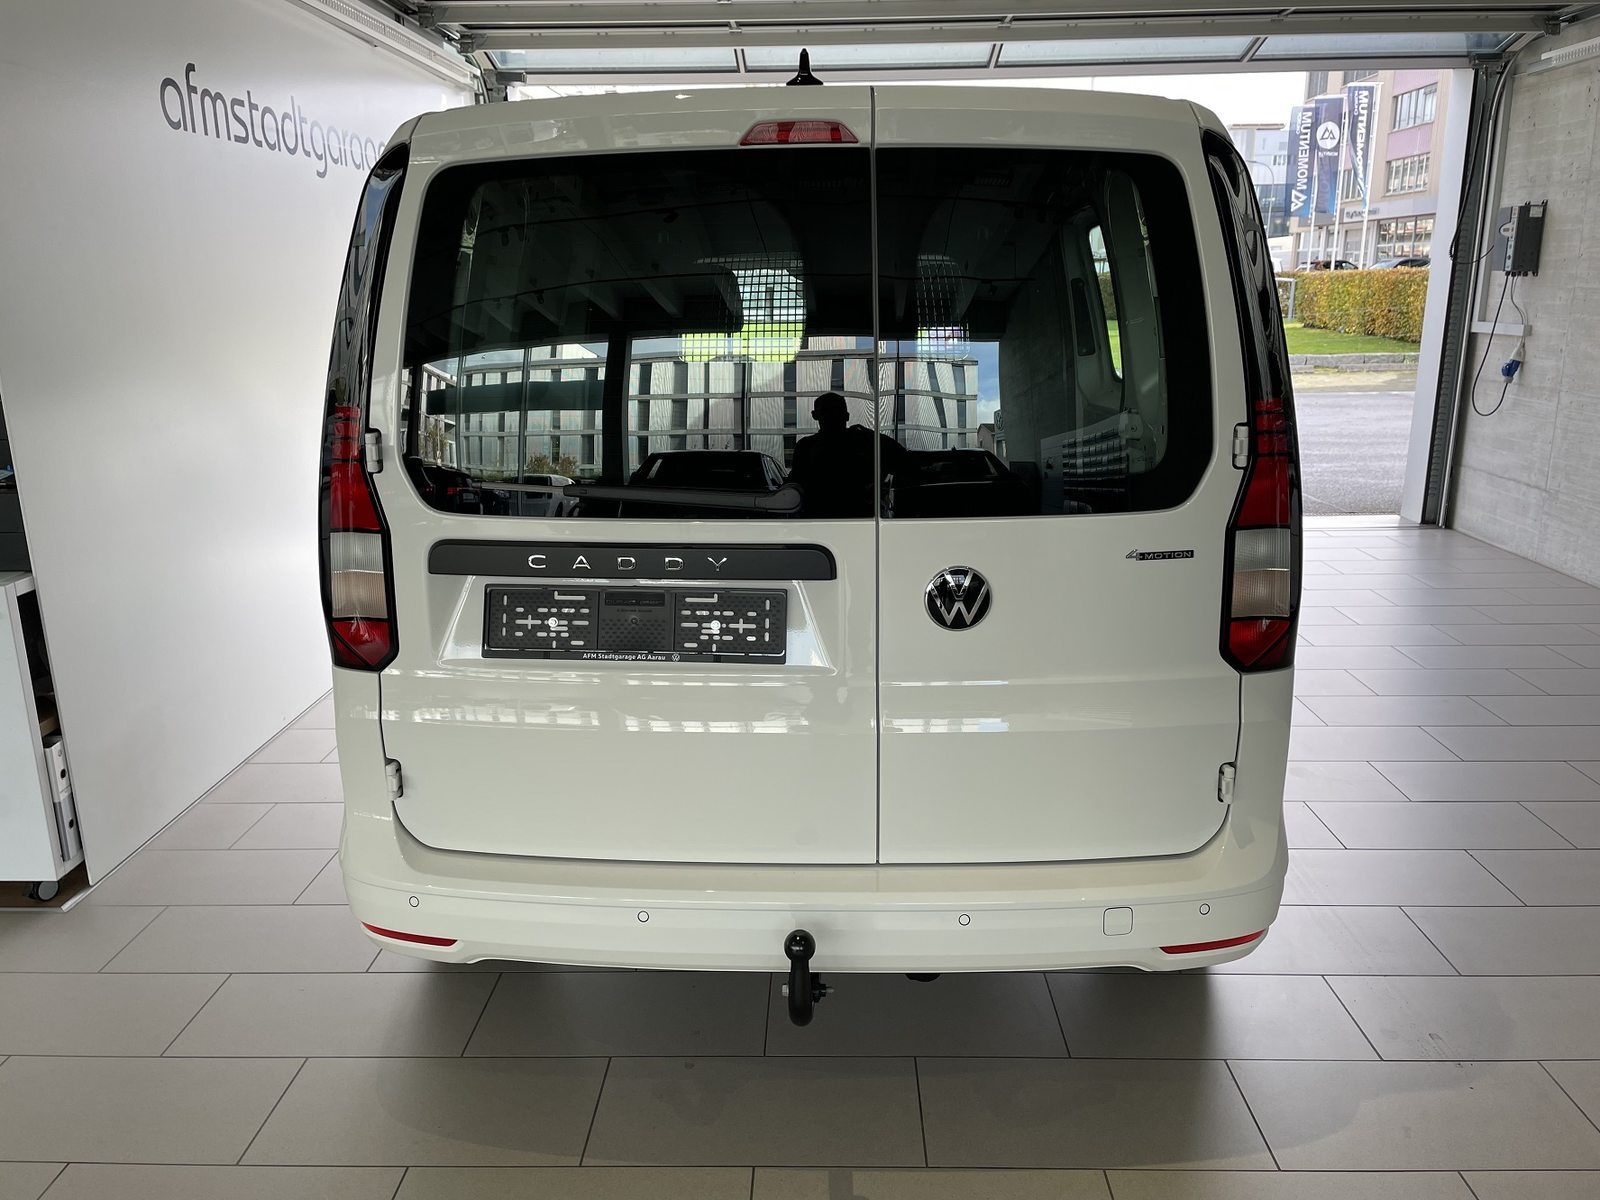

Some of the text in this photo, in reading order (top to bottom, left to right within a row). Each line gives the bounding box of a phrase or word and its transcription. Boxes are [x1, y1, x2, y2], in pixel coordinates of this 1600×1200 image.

[1126, 549, 1192, 561] 4MOTION
[527, 554, 728, 572] CADDY
[598, 653, 636, 661] Stadtgarage
